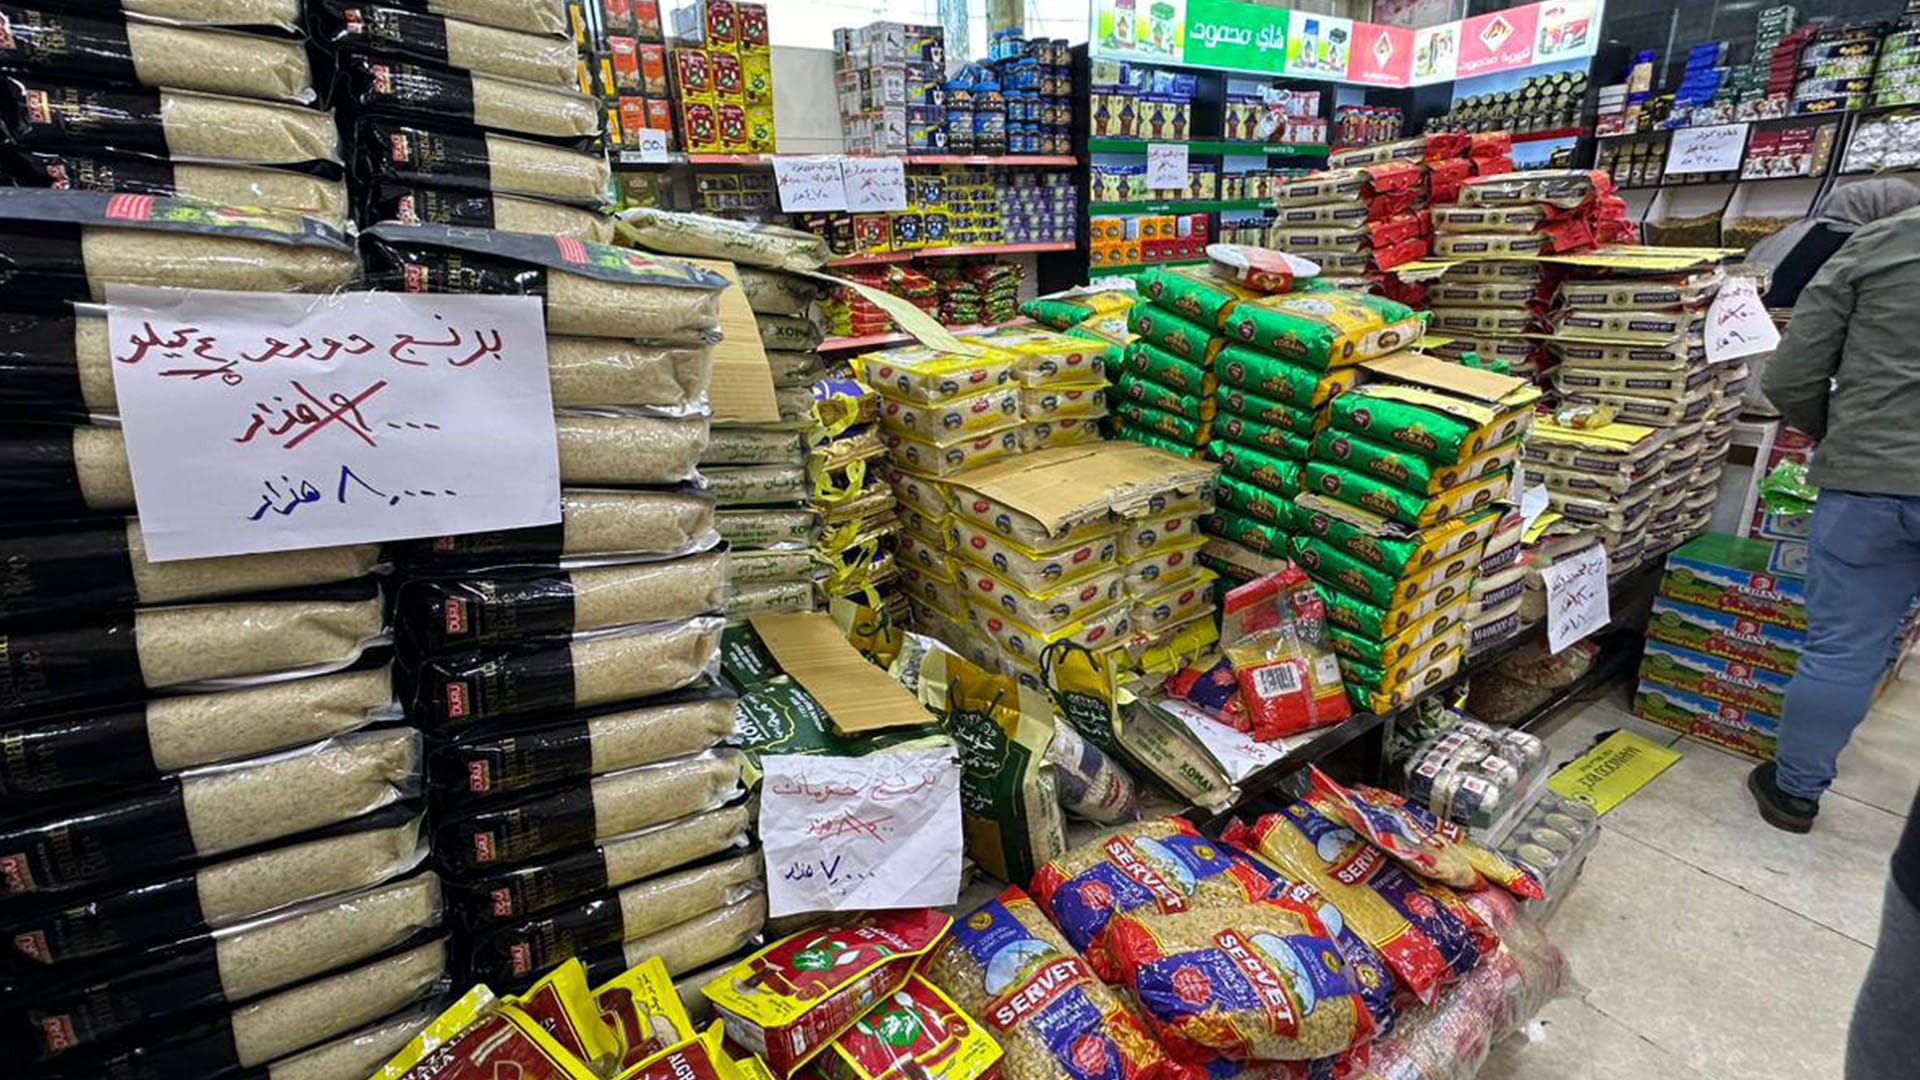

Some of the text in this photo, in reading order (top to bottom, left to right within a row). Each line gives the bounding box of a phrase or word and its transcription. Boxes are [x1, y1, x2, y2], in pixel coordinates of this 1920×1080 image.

[1190, 22, 1252, 48] محمود
[450, 685, 463, 717] DURU
[1107, 840, 1183, 910] SERVET
[1337, 845, 1381, 885] SERVE
[995, 959, 1080, 1026] SERVET
[1218, 933, 1295, 1026] SERVET
[420, 1054, 456, 1080] TEA
